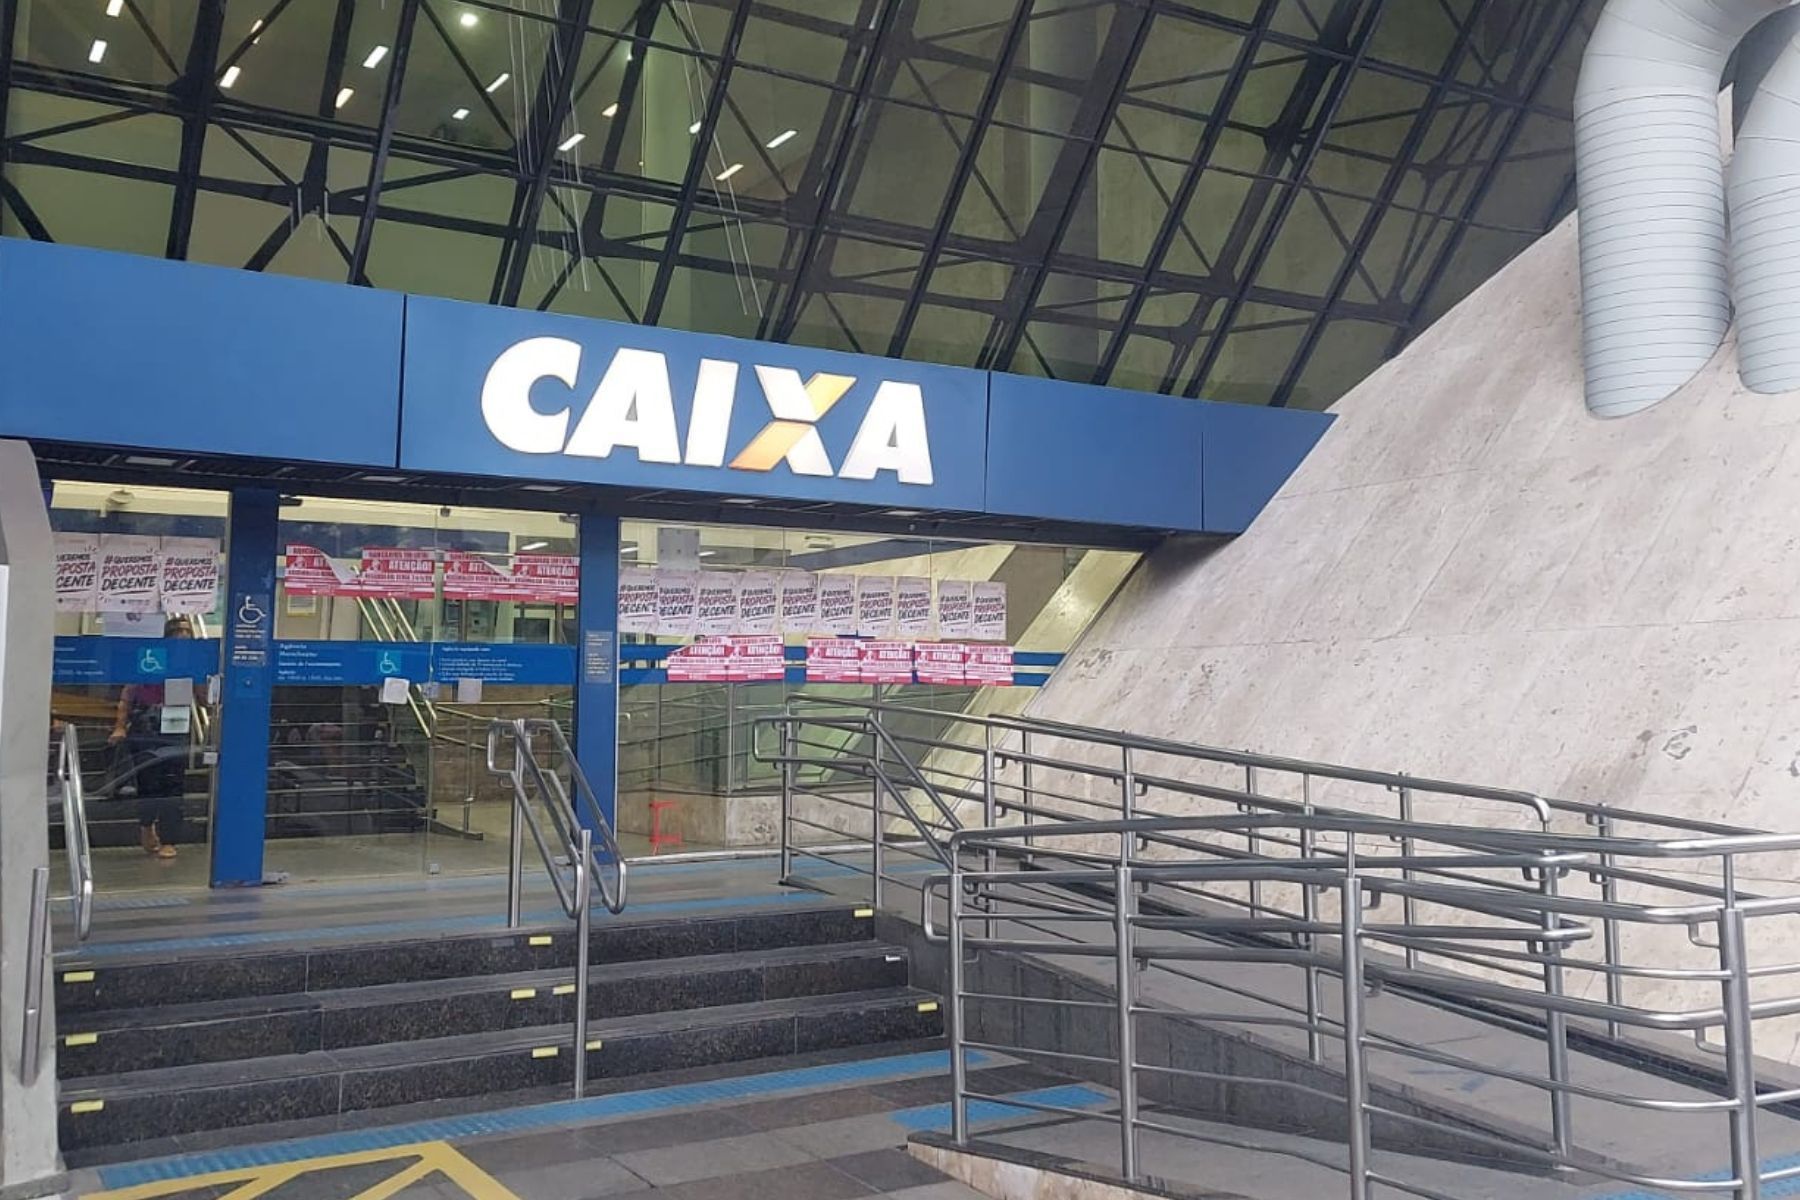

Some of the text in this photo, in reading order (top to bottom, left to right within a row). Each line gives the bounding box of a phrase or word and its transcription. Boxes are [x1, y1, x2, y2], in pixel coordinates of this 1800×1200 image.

[481, 337, 934, 485] CAIXA
[101, 563, 158, 578] PROPOSTA
[163, 565, 217, 580] PROPOSTA
[389, 560, 433, 573] ATENÇÃO!
[56, 575, 95, 589] CENTE
[102, 576, 156, 591] DECENTE
[163, 578, 216, 592] DECENTE
